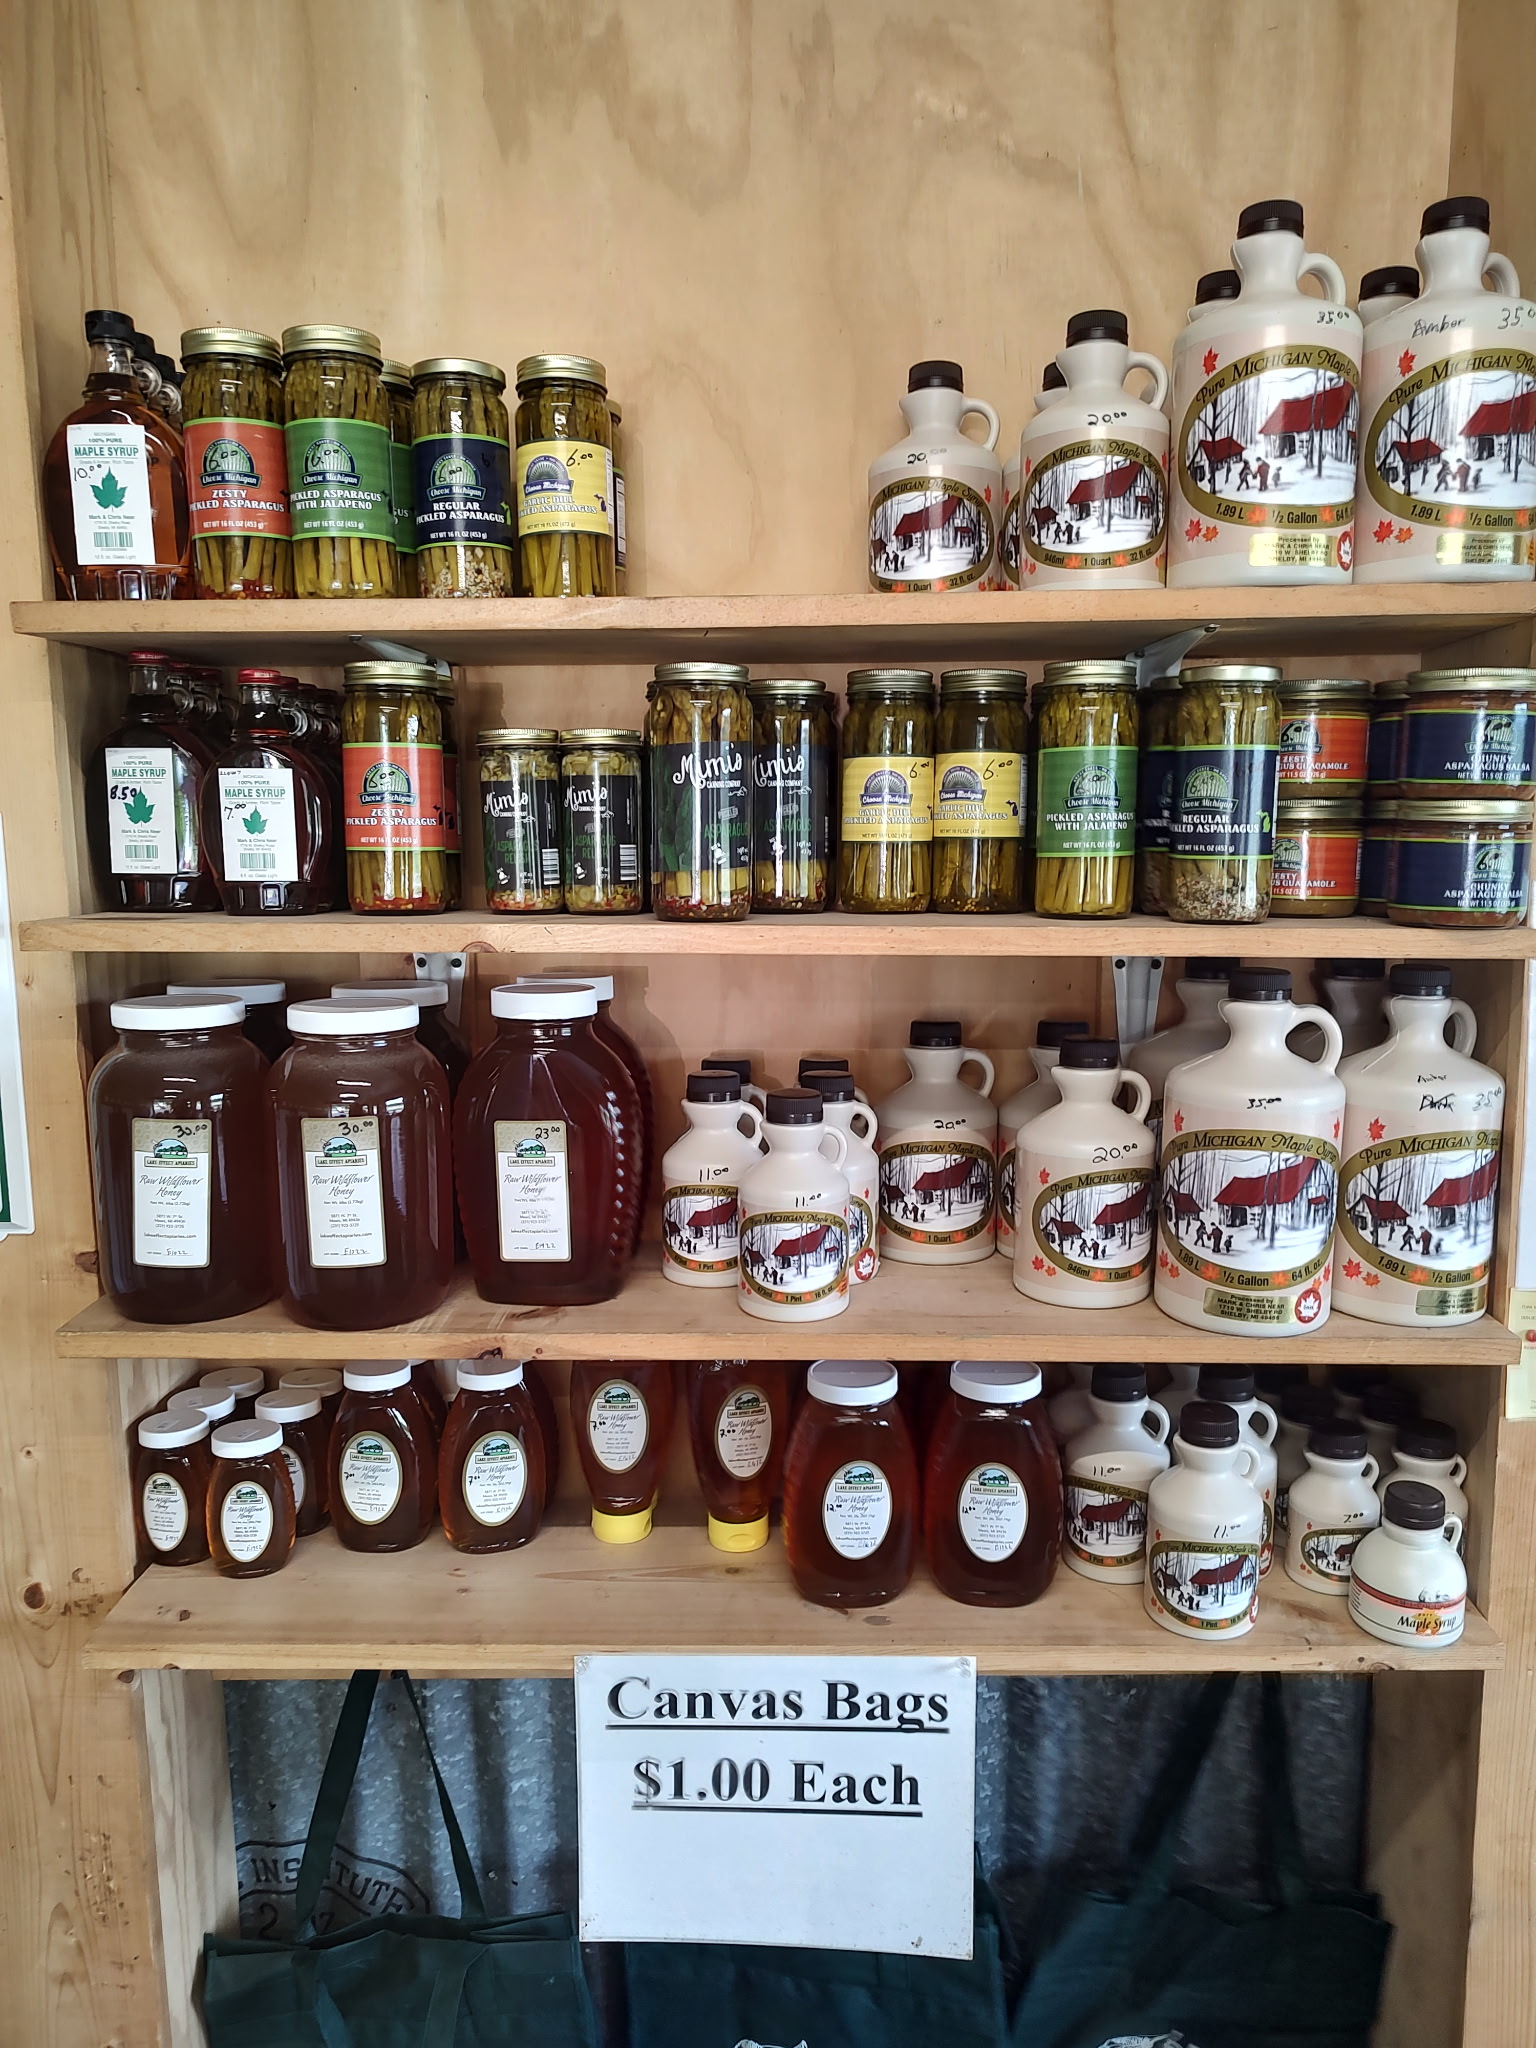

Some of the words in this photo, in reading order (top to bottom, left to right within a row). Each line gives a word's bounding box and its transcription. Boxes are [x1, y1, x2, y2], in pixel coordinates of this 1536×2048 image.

[1194, 377, 1225, 405] Pure
[1231, 352, 1313, 382] MICHIGAN
[1317, 349, 1351, 375] Maple
[1389, 379, 1423, 404] Pure
[1430, 355, 1513, 383] MICHIGAN
[74, 446, 105, 456] MAPLE
[108, 446, 139, 457] SYRUP
[1052, 444, 1105, 464] MICHIGAN
[1109, 441, 1141, 459] Maple
[212, 489, 247, 498] ZESTY
[323, 489, 382, 502] ASPARAGUS
[881, 480, 925, 500] MICHIGAN
[222, 500, 285, 512] ASPARAGUS
[295, 500, 317, 510] WITH
[320, 500, 372, 510] JALAPENO
[433, 502, 480, 511] REGULAR
[523, 496, 550, 506] GARLIC
[540, 504, 597, 514] ASPARAGUS
[1215, 502, 1236, 518] 1.89
[1237, 509, 1244, 520] L
[1286, 511, 1318, 525] Gallon
[1410, 503, 1433, 520] 1.89
[1435, 510, 1442, 522] L
[1484, 512, 1513, 527] Gallon
[449, 511, 505, 523] ASPARAGUS
[1090, 557, 1112, 566] Quart
[913, 583, 932, 591] Quart
[1470, 754, 1513, 763] CHUNKY
[1296, 762, 1349, 770] GUACAMOLE
[1443, 761, 1504, 771] ASPAAGUS
[111, 768, 138, 777] MAPLE
[140, 768, 167, 777] SYRUP
[110, 784, 138, 800] 8.50
[224, 788, 252, 797] MAPLE
[255, 788, 286, 797] SYRUP
[371, 808, 404, 817] ZESTY
[859, 808, 890, 816] GARLIC
[953, 812, 1008, 820] ASPARAGUS
[1046, 813, 1084, 821] PICKLED
[1087, 812, 1134, 821] ASPARAGUS
[346, 817, 377, 826] PICKLED
[380, 817, 437, 826] ASPARAGUS
[878, 816, 929, 824] ASPARAGUS
[1182, 815, 1229, 824] REGULAR
[1054, 822, 1080, 831] WITH
[1083, 822, 1128, 830] JALAPENO
[1196, 824, 1259, 833] ASPARAGUS
[1470, 882, 1510, 891] CHUNKY
[338, 1121, 374, 1136] 30.00
[900, 1144, 946, 1153] MICHIGAN
[1092, 1142, 1138, 1163] 20.00
[1194, 1131, 1267, 1148] MICHIGAN
[1271, 1133, 1314, 1153] Maple
[1316, 1140, 1337, 1163] Syrup
[1359, 1147, 1392, 1164] Pure
[1398, 1136, 1474, 1154] MICHIGAN
[139, 1174, 157, 1184] Raw
[157, 1174, 204, 1191] Wildflower
[312, 1174, 329, 1184] Raw
[330, 1173, 375, 1187] Wildflower
[522, 1173, 562, 1186] Wildflower
[1077, 1172, 1127, 1187] MICHIGAN
[155, 1187, 183, 1200] Honey
[328, 1186, 355, 1199] Honey
[519, 1184, 544, 1197] Honey
[680, 1186, 716, 1195] MICHIGAN
[764, 1213, 805, 1223] MICHIGAN
[1067, 1263, 1091, 1277] 946ml
[1177, 1248, 1194, 1266] 1.89
[1237, 1274, 1270, 1287] Gallon
[1291, 1271, 1303, 1282] 64
[1376, 1255, 1400, 1273] 1.89
[1400, 1265, 1407, 1276] L
[1445, 1271, 1471, 1283] Gallon
[1217, 1297, 1237, 1306] MARK
[1396, 1614, 1432, 1630] Maple
[1432, 1614, 1457, 1631] Syrup
[606, 1676, 802, 1721] Canvas
[822, 1678, 950, 1734] Bags
[633, 1755, 771, 1805] $1.00
[792, 1759, 923, 1807] Each
[250, 1858, 414, 1918] INSTUTE
